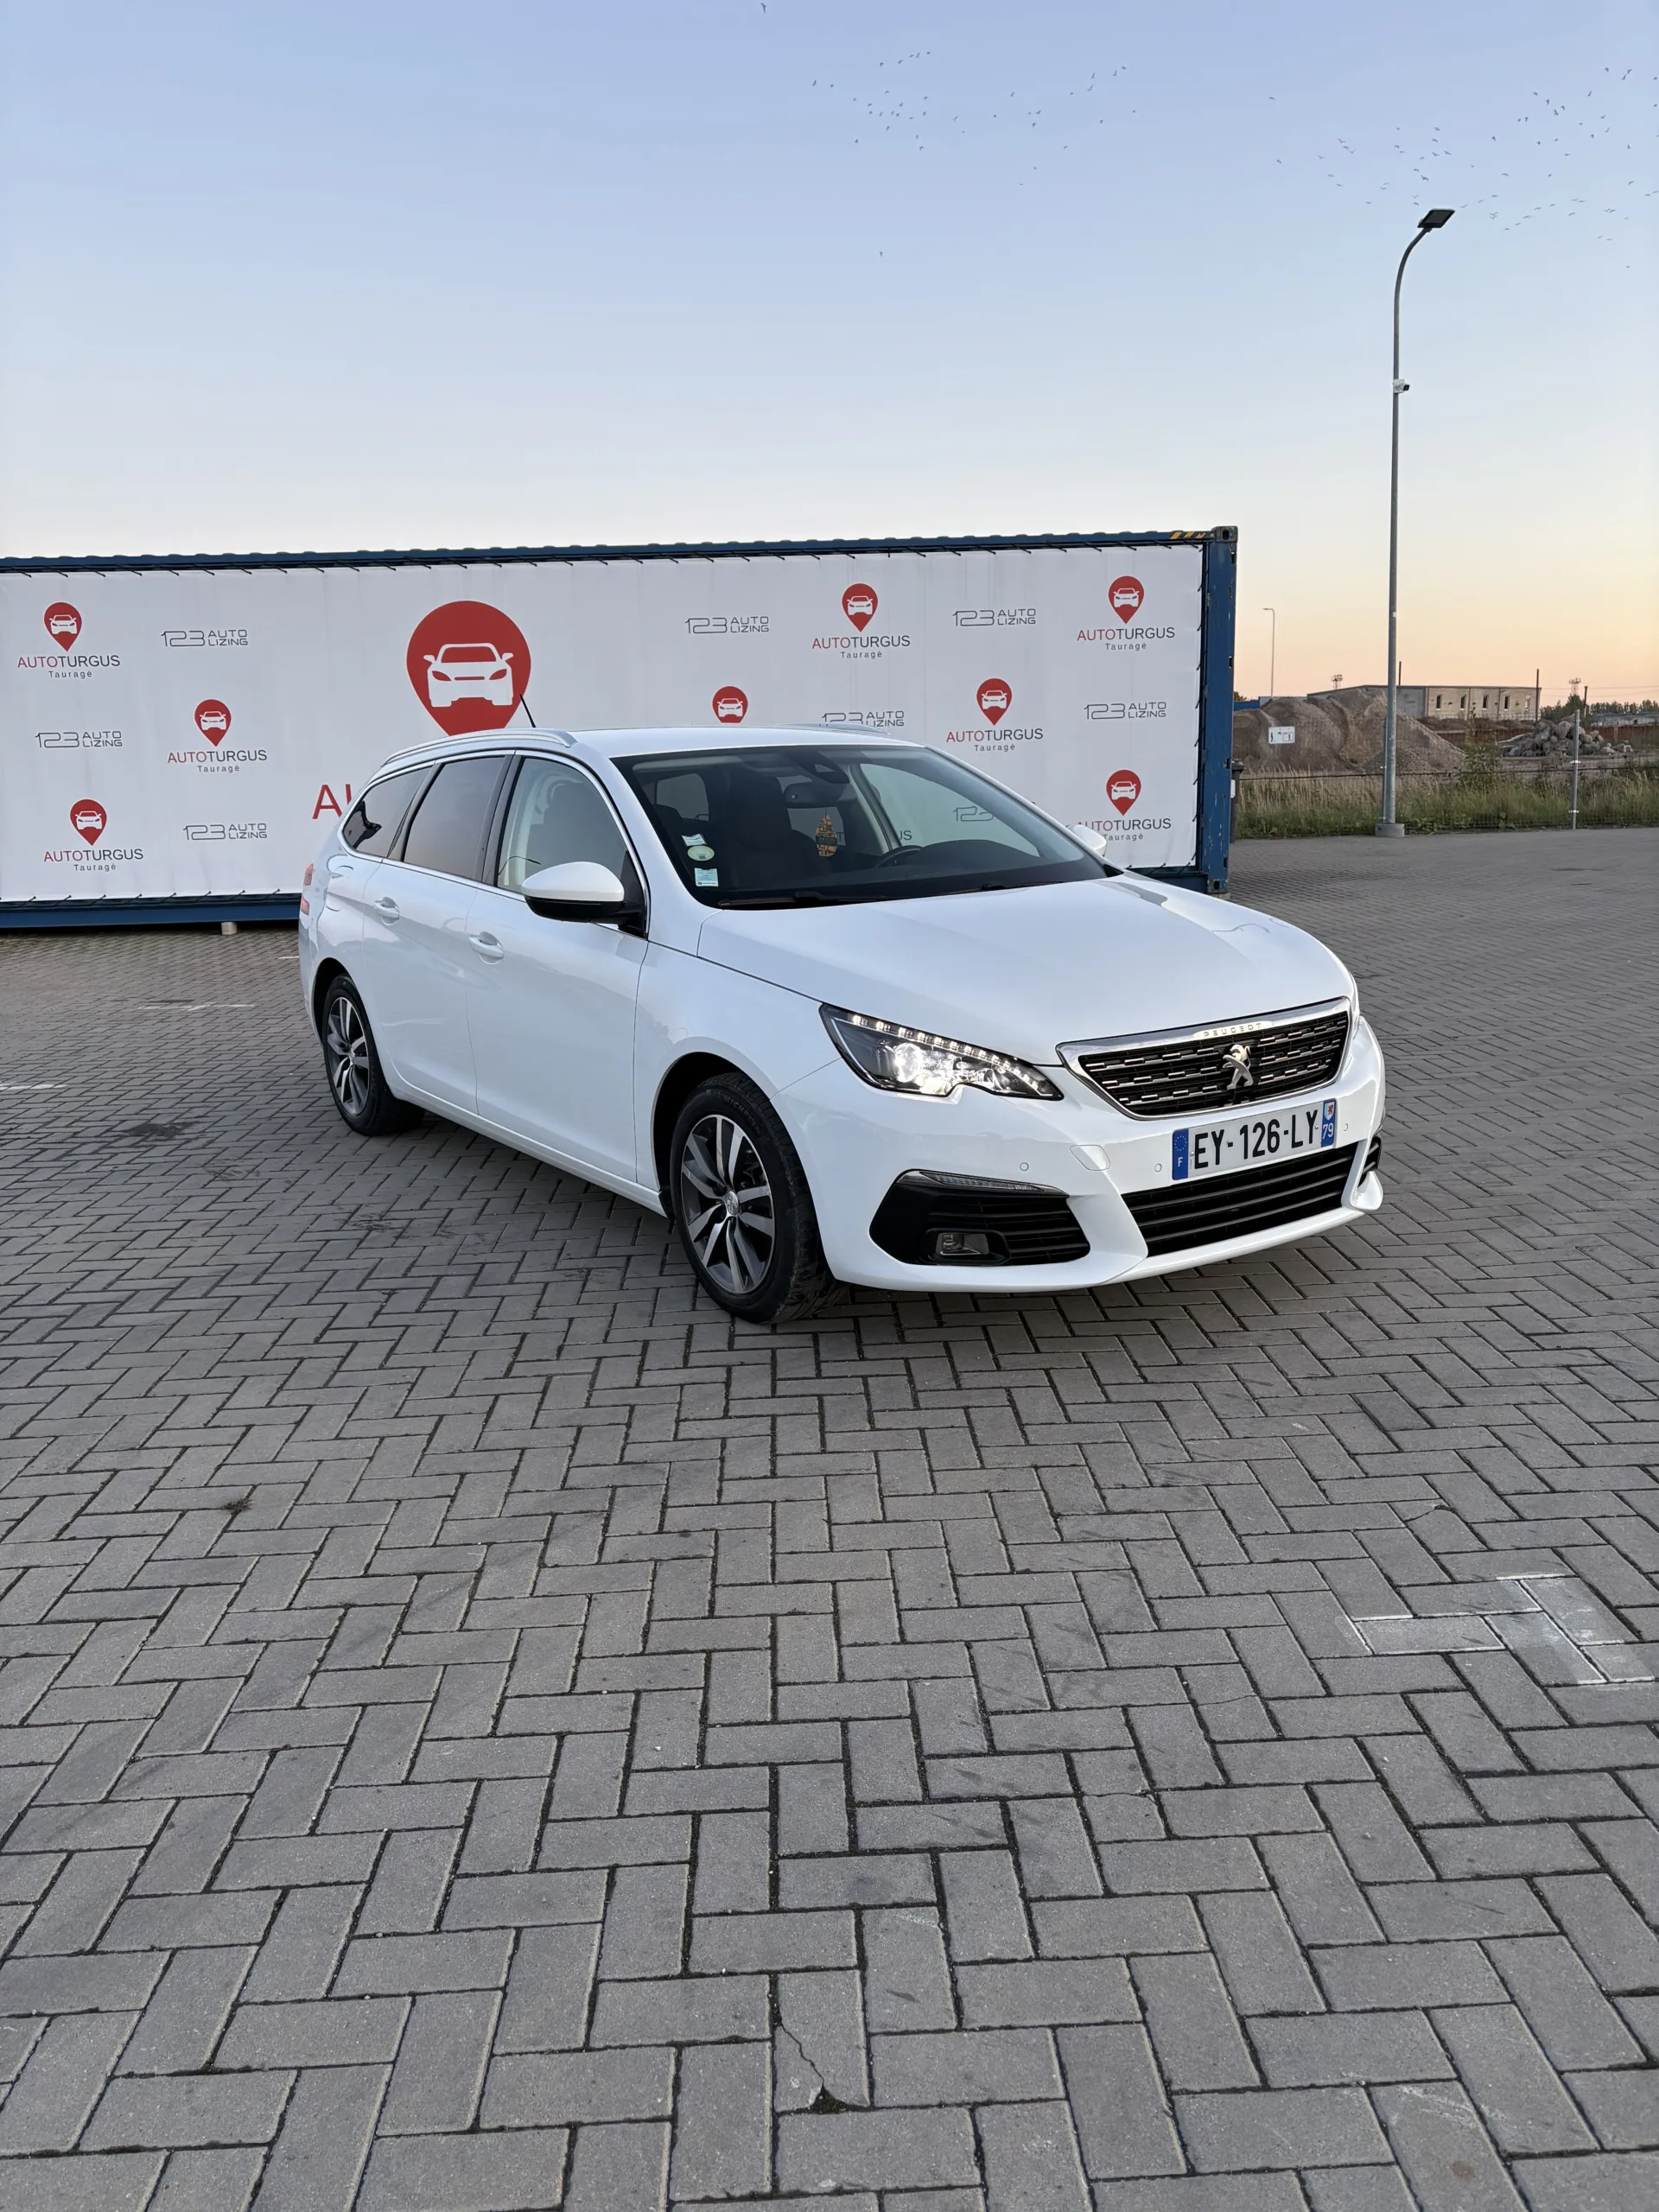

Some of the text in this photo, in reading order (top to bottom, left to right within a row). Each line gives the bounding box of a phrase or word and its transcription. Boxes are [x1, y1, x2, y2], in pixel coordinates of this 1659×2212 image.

[684, 615, 769, 634] 123 AUTO
[952, 607, 1037, 627] 123 AUTO
[997, 616, 1037, 626] LIZING
[730, 624, 770, 633] LIZING
[1077, 626, 1176, 641] AUTOTURGUS
[160, 629, 248, 647] 123 AUTO
[207, 637, 249, 646] LIZING
[811, 634, 911, 650] AUTOTURGUS
[17, 654, 121, 669] AUTOTURGUS
[1083, 701, 1167, 721] 123 AUTO
[1128, 710, 1166, 719] LIZING
[35, 730, 122, 749] 123 AUTO
[82, 738, 123, 748] LIZING
[945, 728, 1044, 743] AUTOTURGUS
[167, 749, 268, 764] AUTOTURGUS
[182, 823, 226, 841] 123
[228, 830, 268, 840] LIZING
[43, 848, 144, 862] AUTOTURGUS
[1203, 1022, 1262, 1037] PEUGEOT
[1177, 1109, 1335, 1170] F EY-126-LY 79
